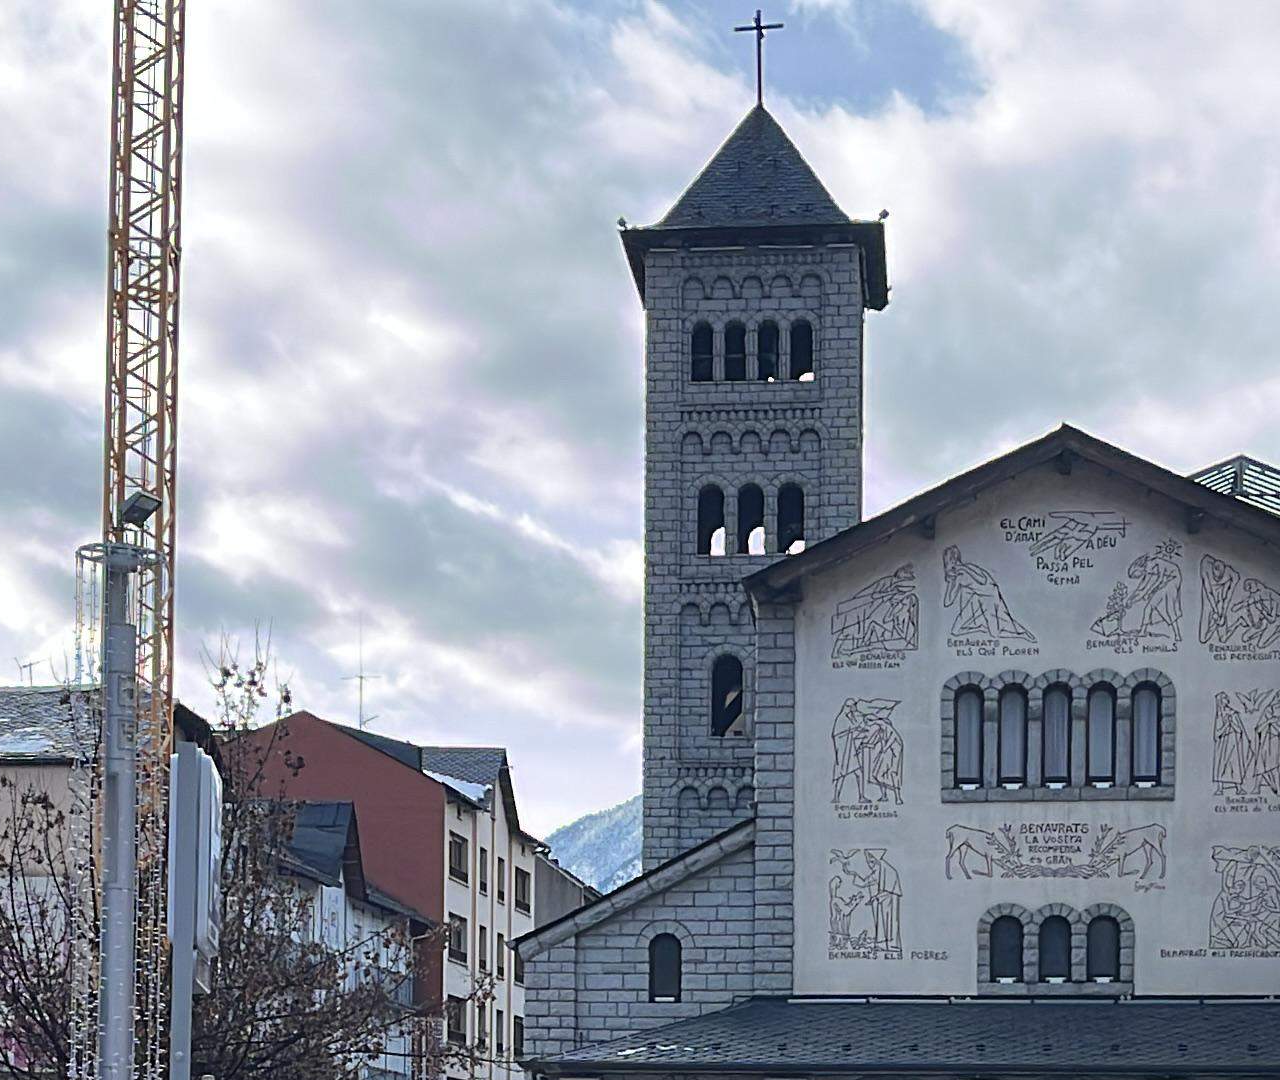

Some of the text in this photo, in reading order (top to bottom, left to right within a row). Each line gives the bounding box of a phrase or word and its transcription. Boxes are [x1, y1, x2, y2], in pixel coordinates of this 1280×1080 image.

[1000, 518, 1016, 529] EL
[1036, 556, 1094, 573] PASSA PEL
[1020, 823, 1089, 834] BENAURATS
